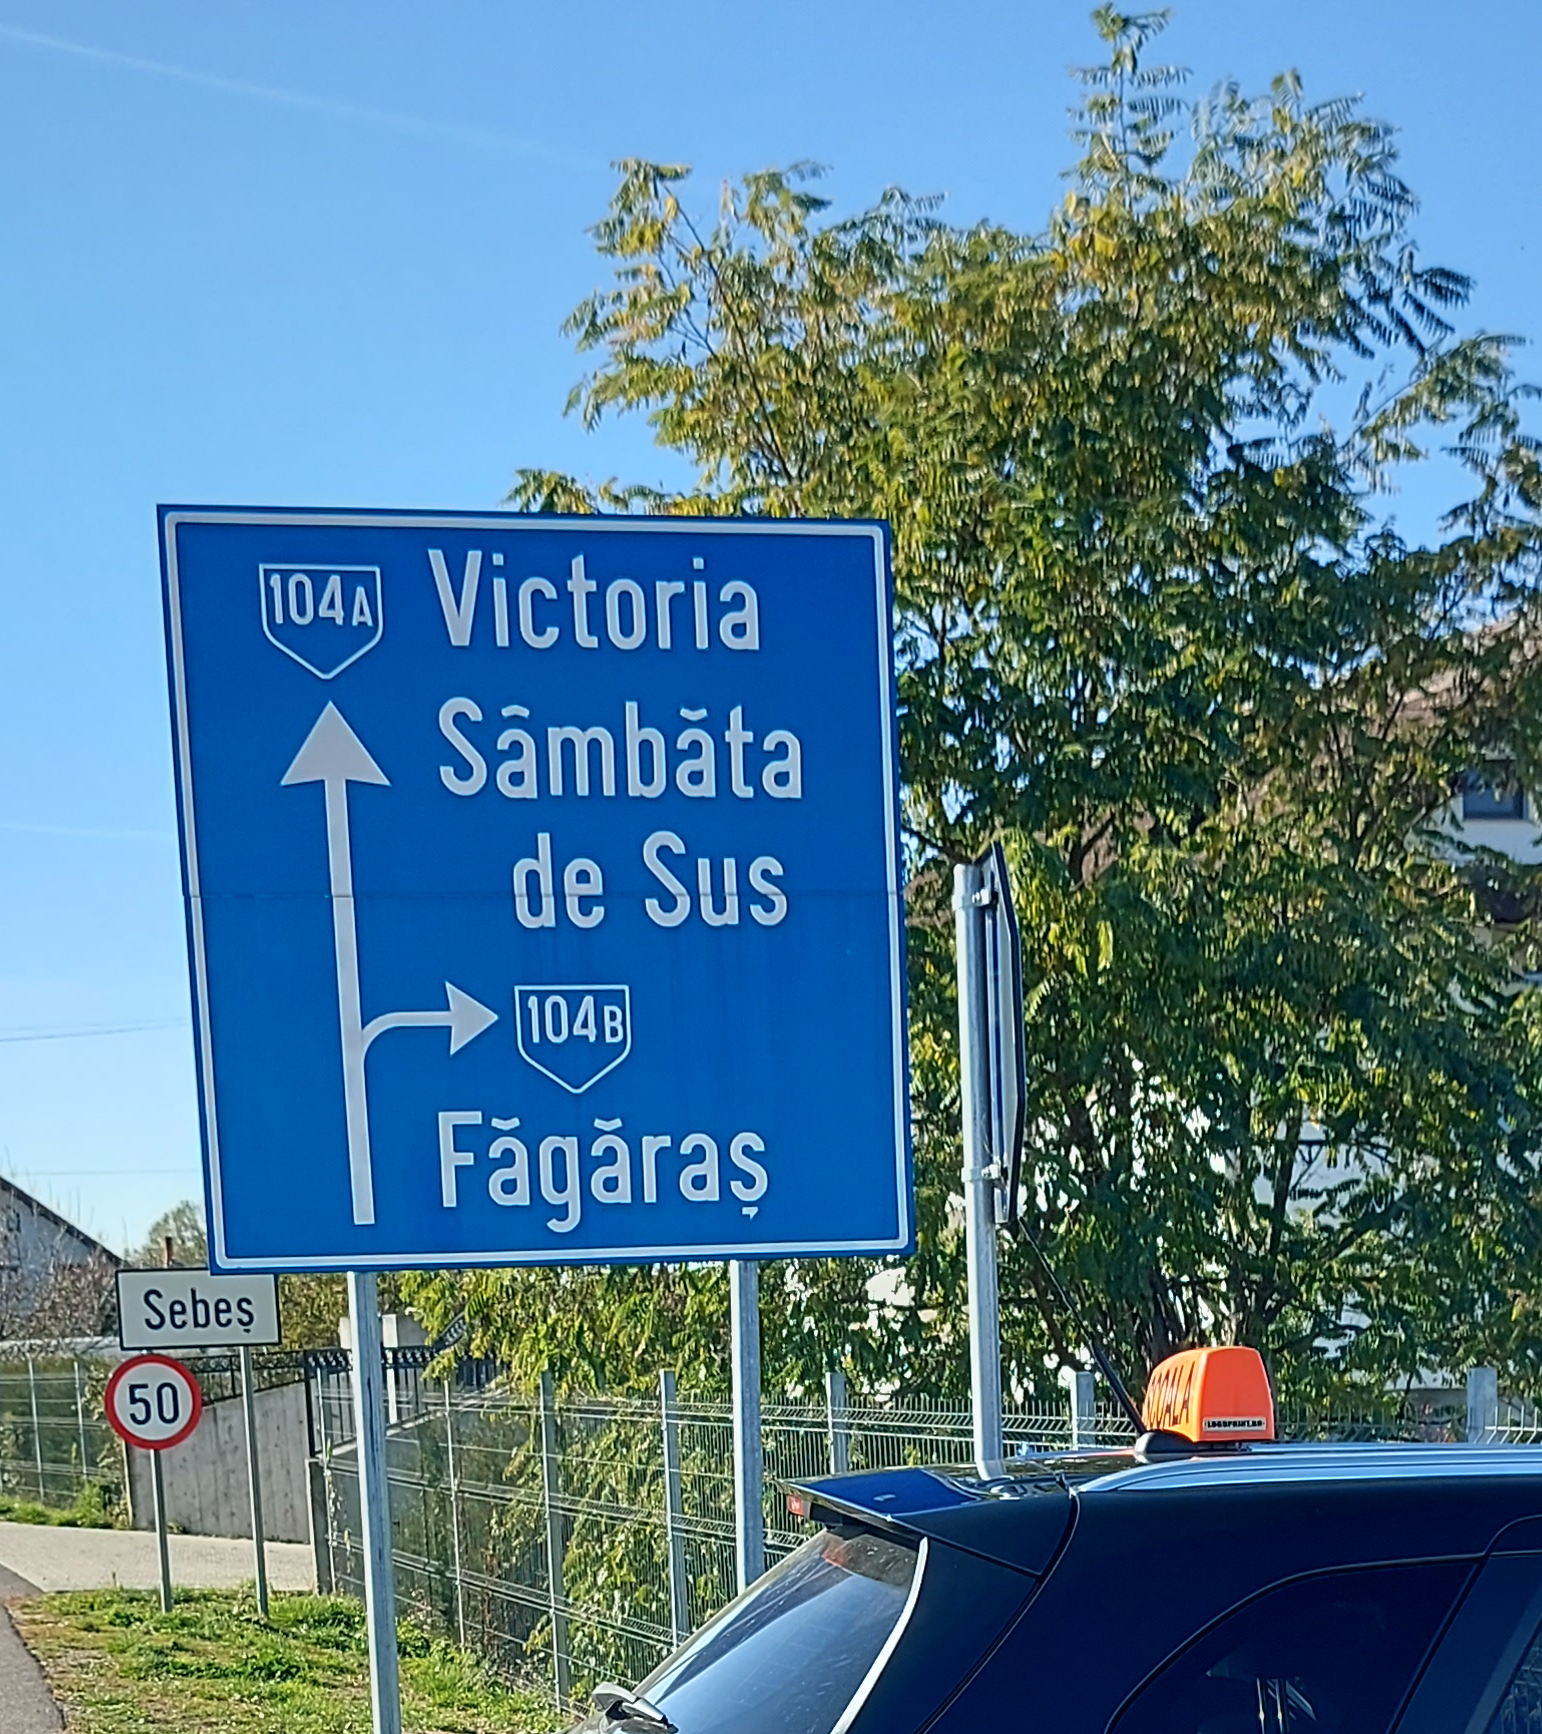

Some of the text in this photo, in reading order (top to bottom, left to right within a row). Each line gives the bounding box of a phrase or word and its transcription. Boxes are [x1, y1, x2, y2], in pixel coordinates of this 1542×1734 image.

[268, 572, 374, 627] 104A
[427, 548, 761, 651] Victoria
[438, 696, 803, 800] Sâmbăta
[512, 830, 789, 929] de Sus
[527, 994, 625, 1045] 104B
[438, 1110, 769, 1234] Făgăraș
[143, 1287, 255, 1334] Sebeș
[127, 1381, 181, 1426] 50
